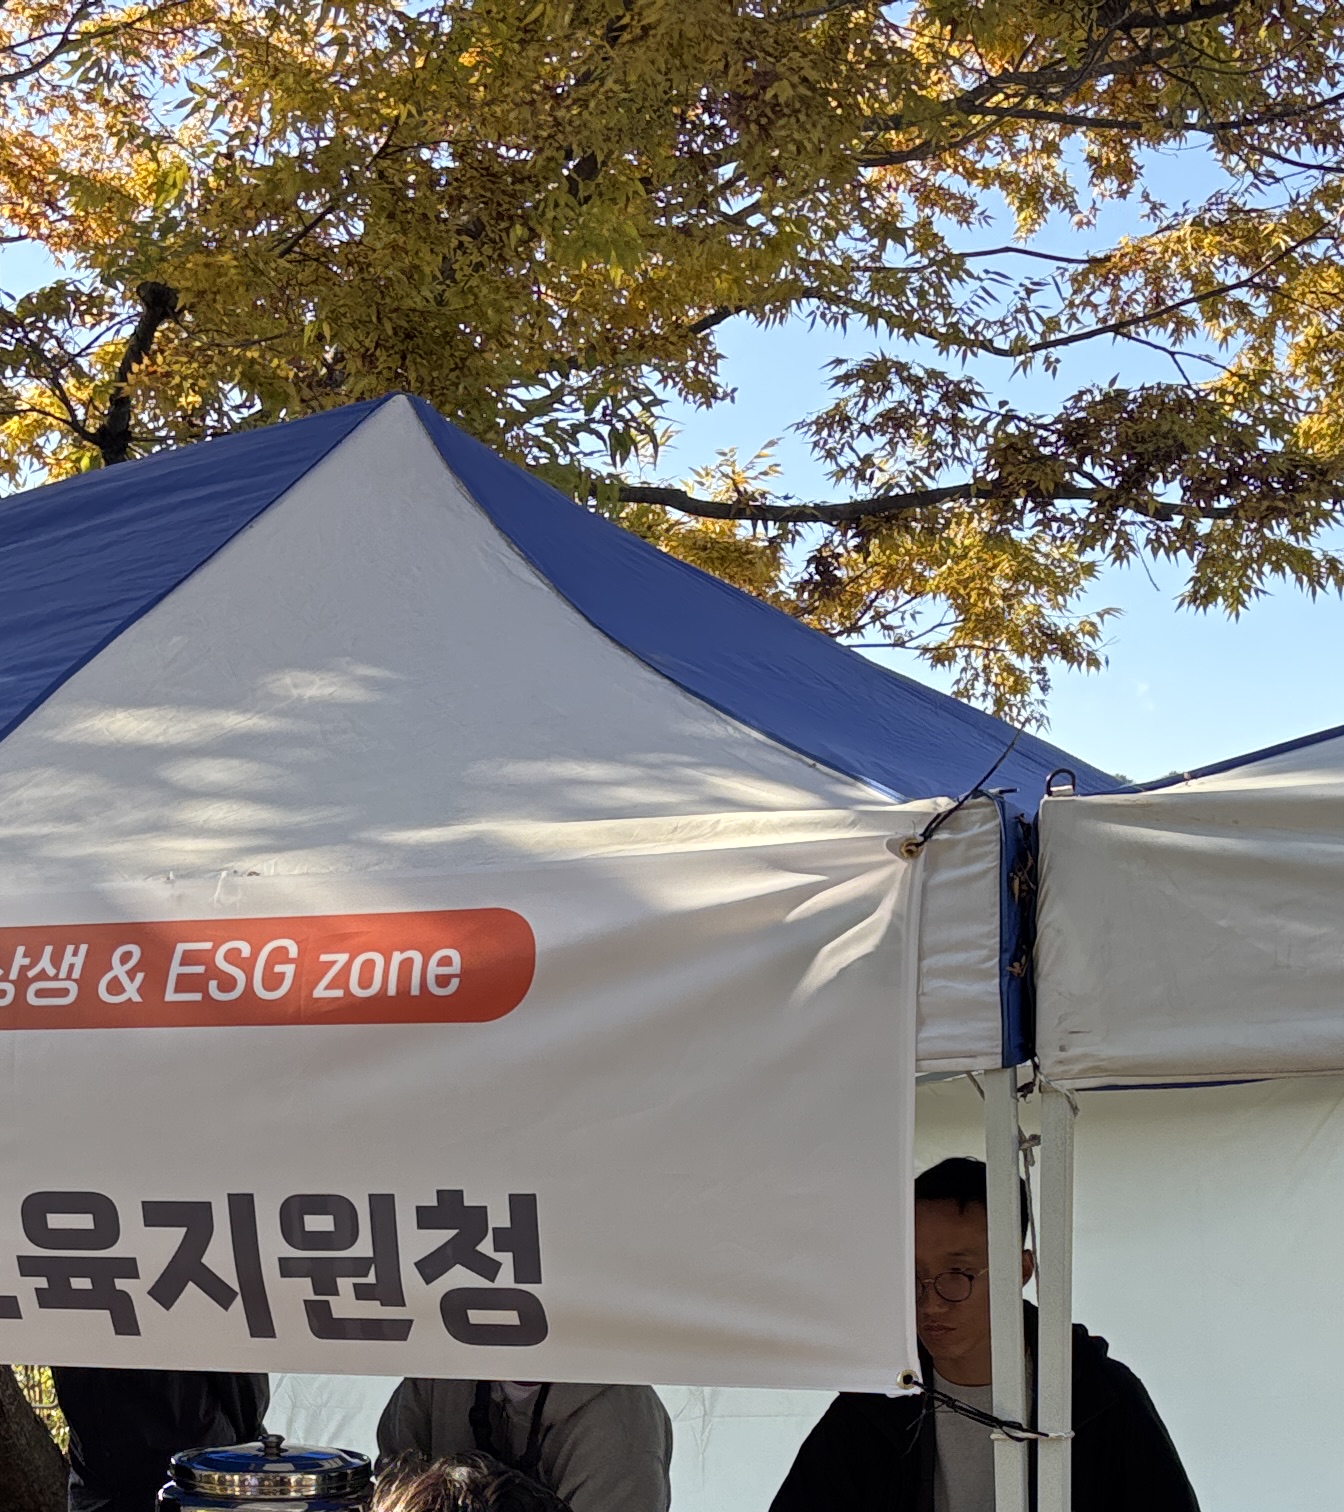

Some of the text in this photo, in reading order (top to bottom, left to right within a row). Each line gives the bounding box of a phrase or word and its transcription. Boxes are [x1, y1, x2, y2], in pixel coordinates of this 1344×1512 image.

[97, 946, 144, 1004] &
[165, 939, 297, 1001] ESG
[320, 946, 462, 999] zone
